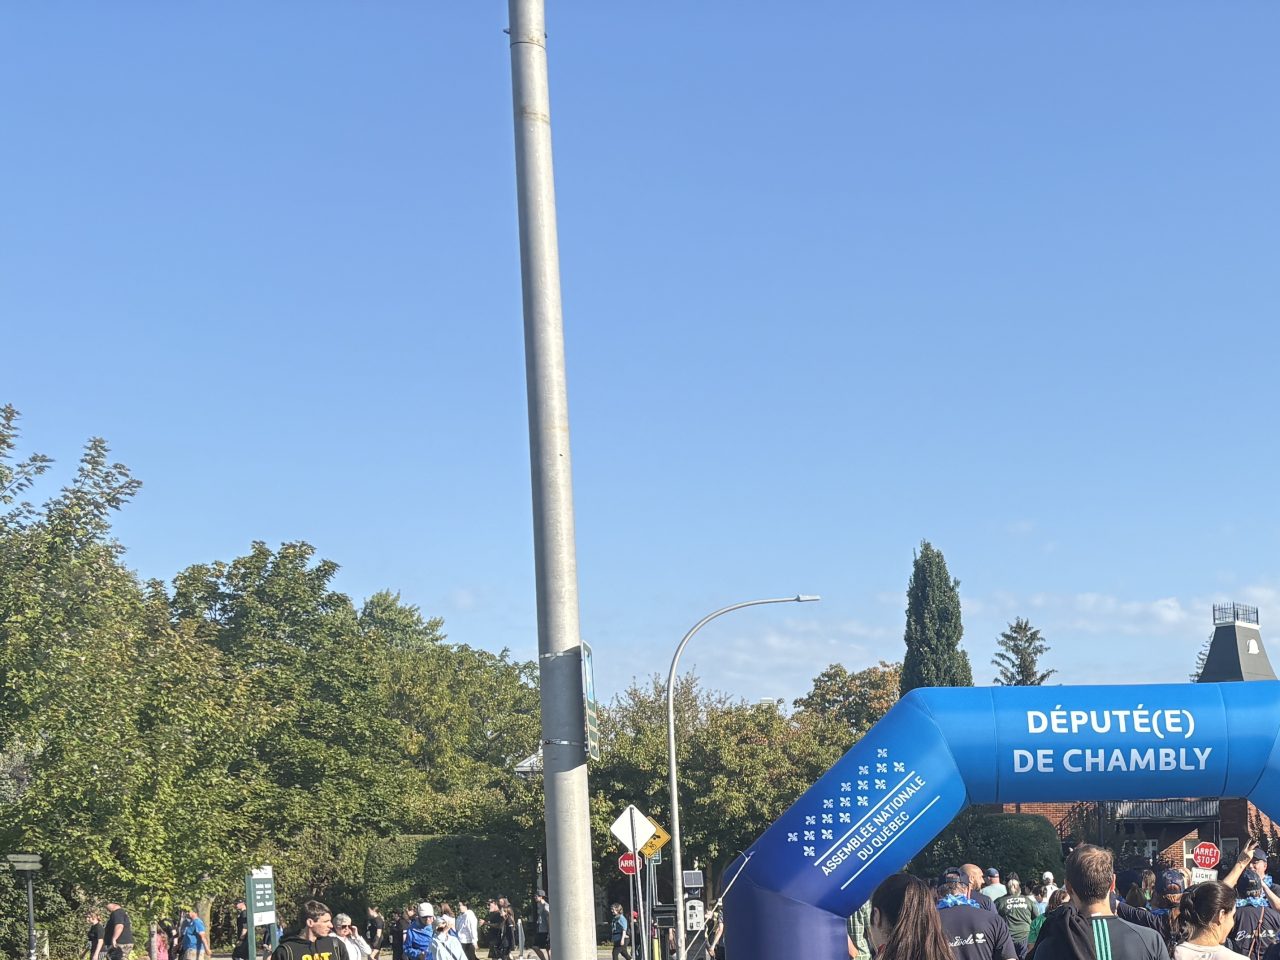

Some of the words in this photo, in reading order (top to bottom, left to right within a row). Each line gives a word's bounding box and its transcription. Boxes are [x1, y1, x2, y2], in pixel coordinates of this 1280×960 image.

[1026, 703, 1195, 739] DÉPUTÉ(E)
[1013, 749, 1054, 773] DE
[1062, 747, 1213, 772] CHAMBLY
[821, 822, 877, 877] ASSEMBLÉE
[872, 775, 927, 827] NATIONALE
[856, 844, 874, 861] DU
[872, 810, 910, 847] QUÉBEC
[1197, 855, 1216, 864] STOP
